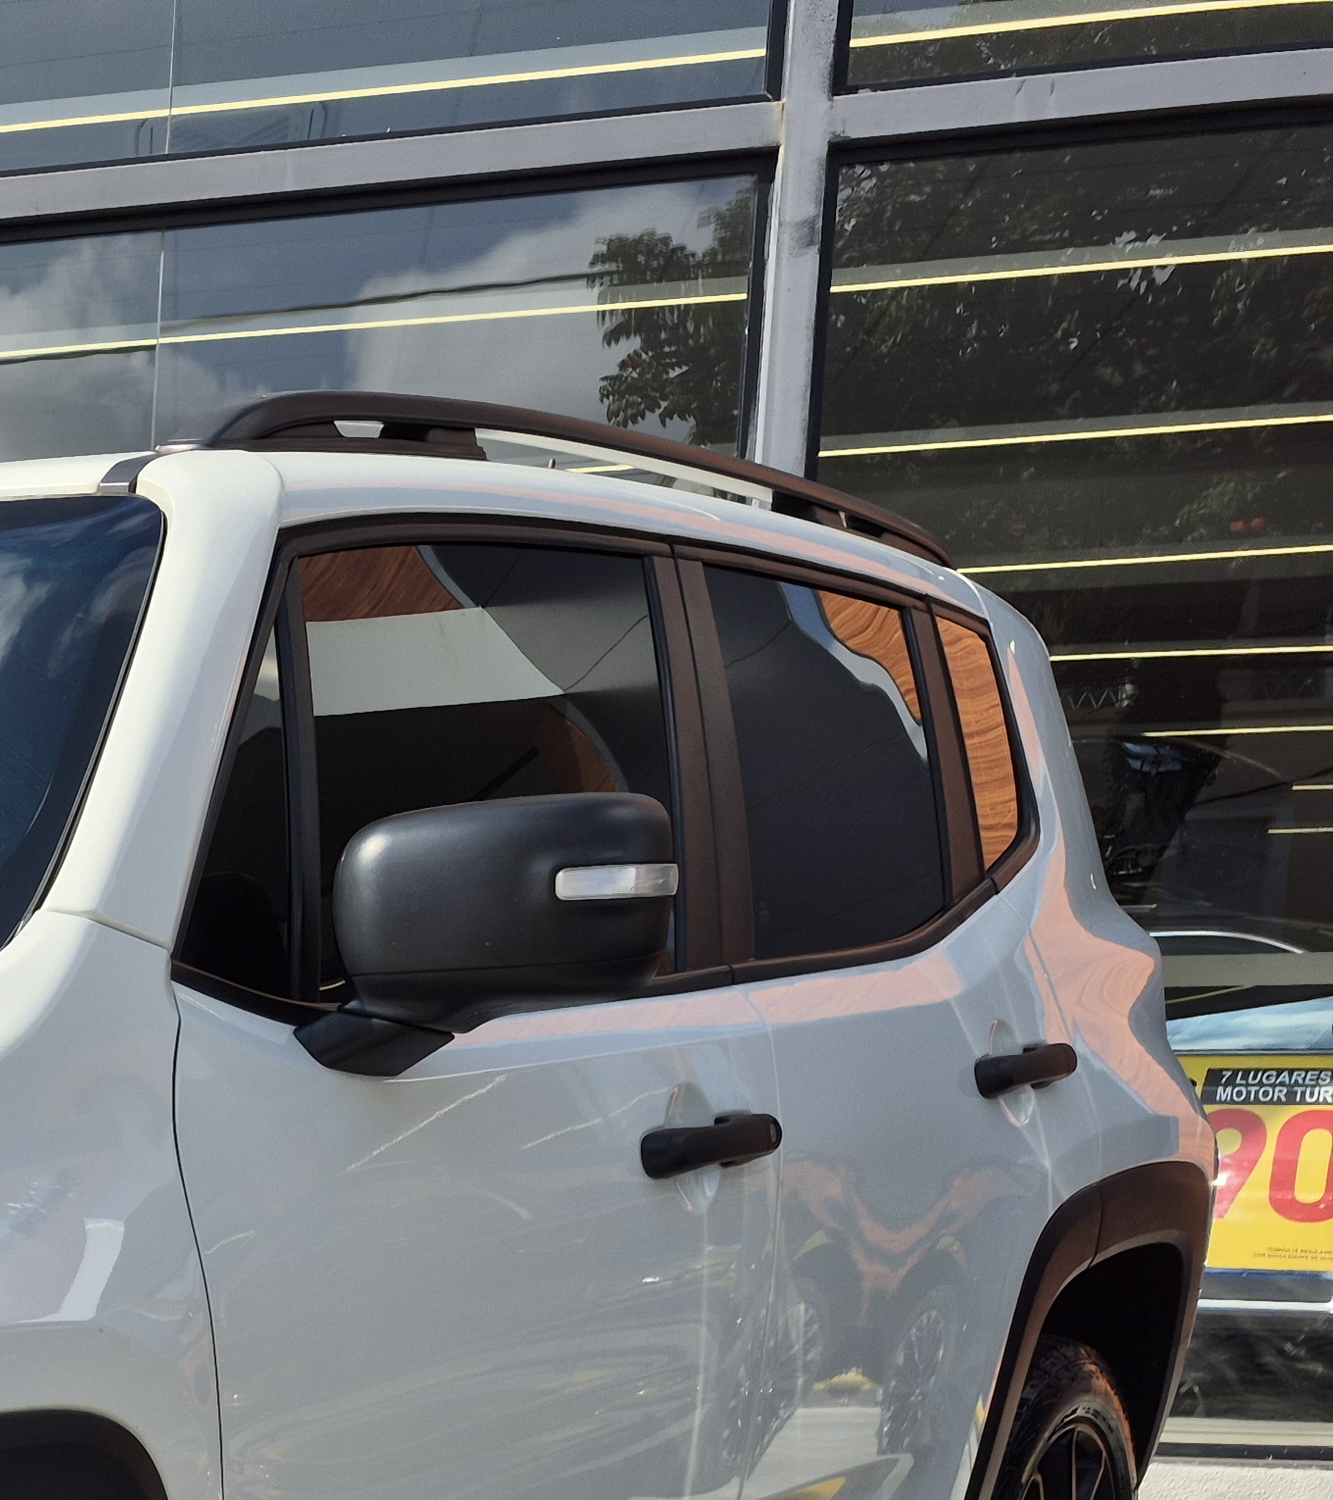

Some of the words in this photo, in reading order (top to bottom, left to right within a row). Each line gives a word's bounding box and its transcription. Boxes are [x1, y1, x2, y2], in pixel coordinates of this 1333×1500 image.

[1220, 1071, 1233, 1084] 7
[1236, 1070, 1331, 1085] LUGARES
[1216, 1087, 1287, 1102] MOTOR
